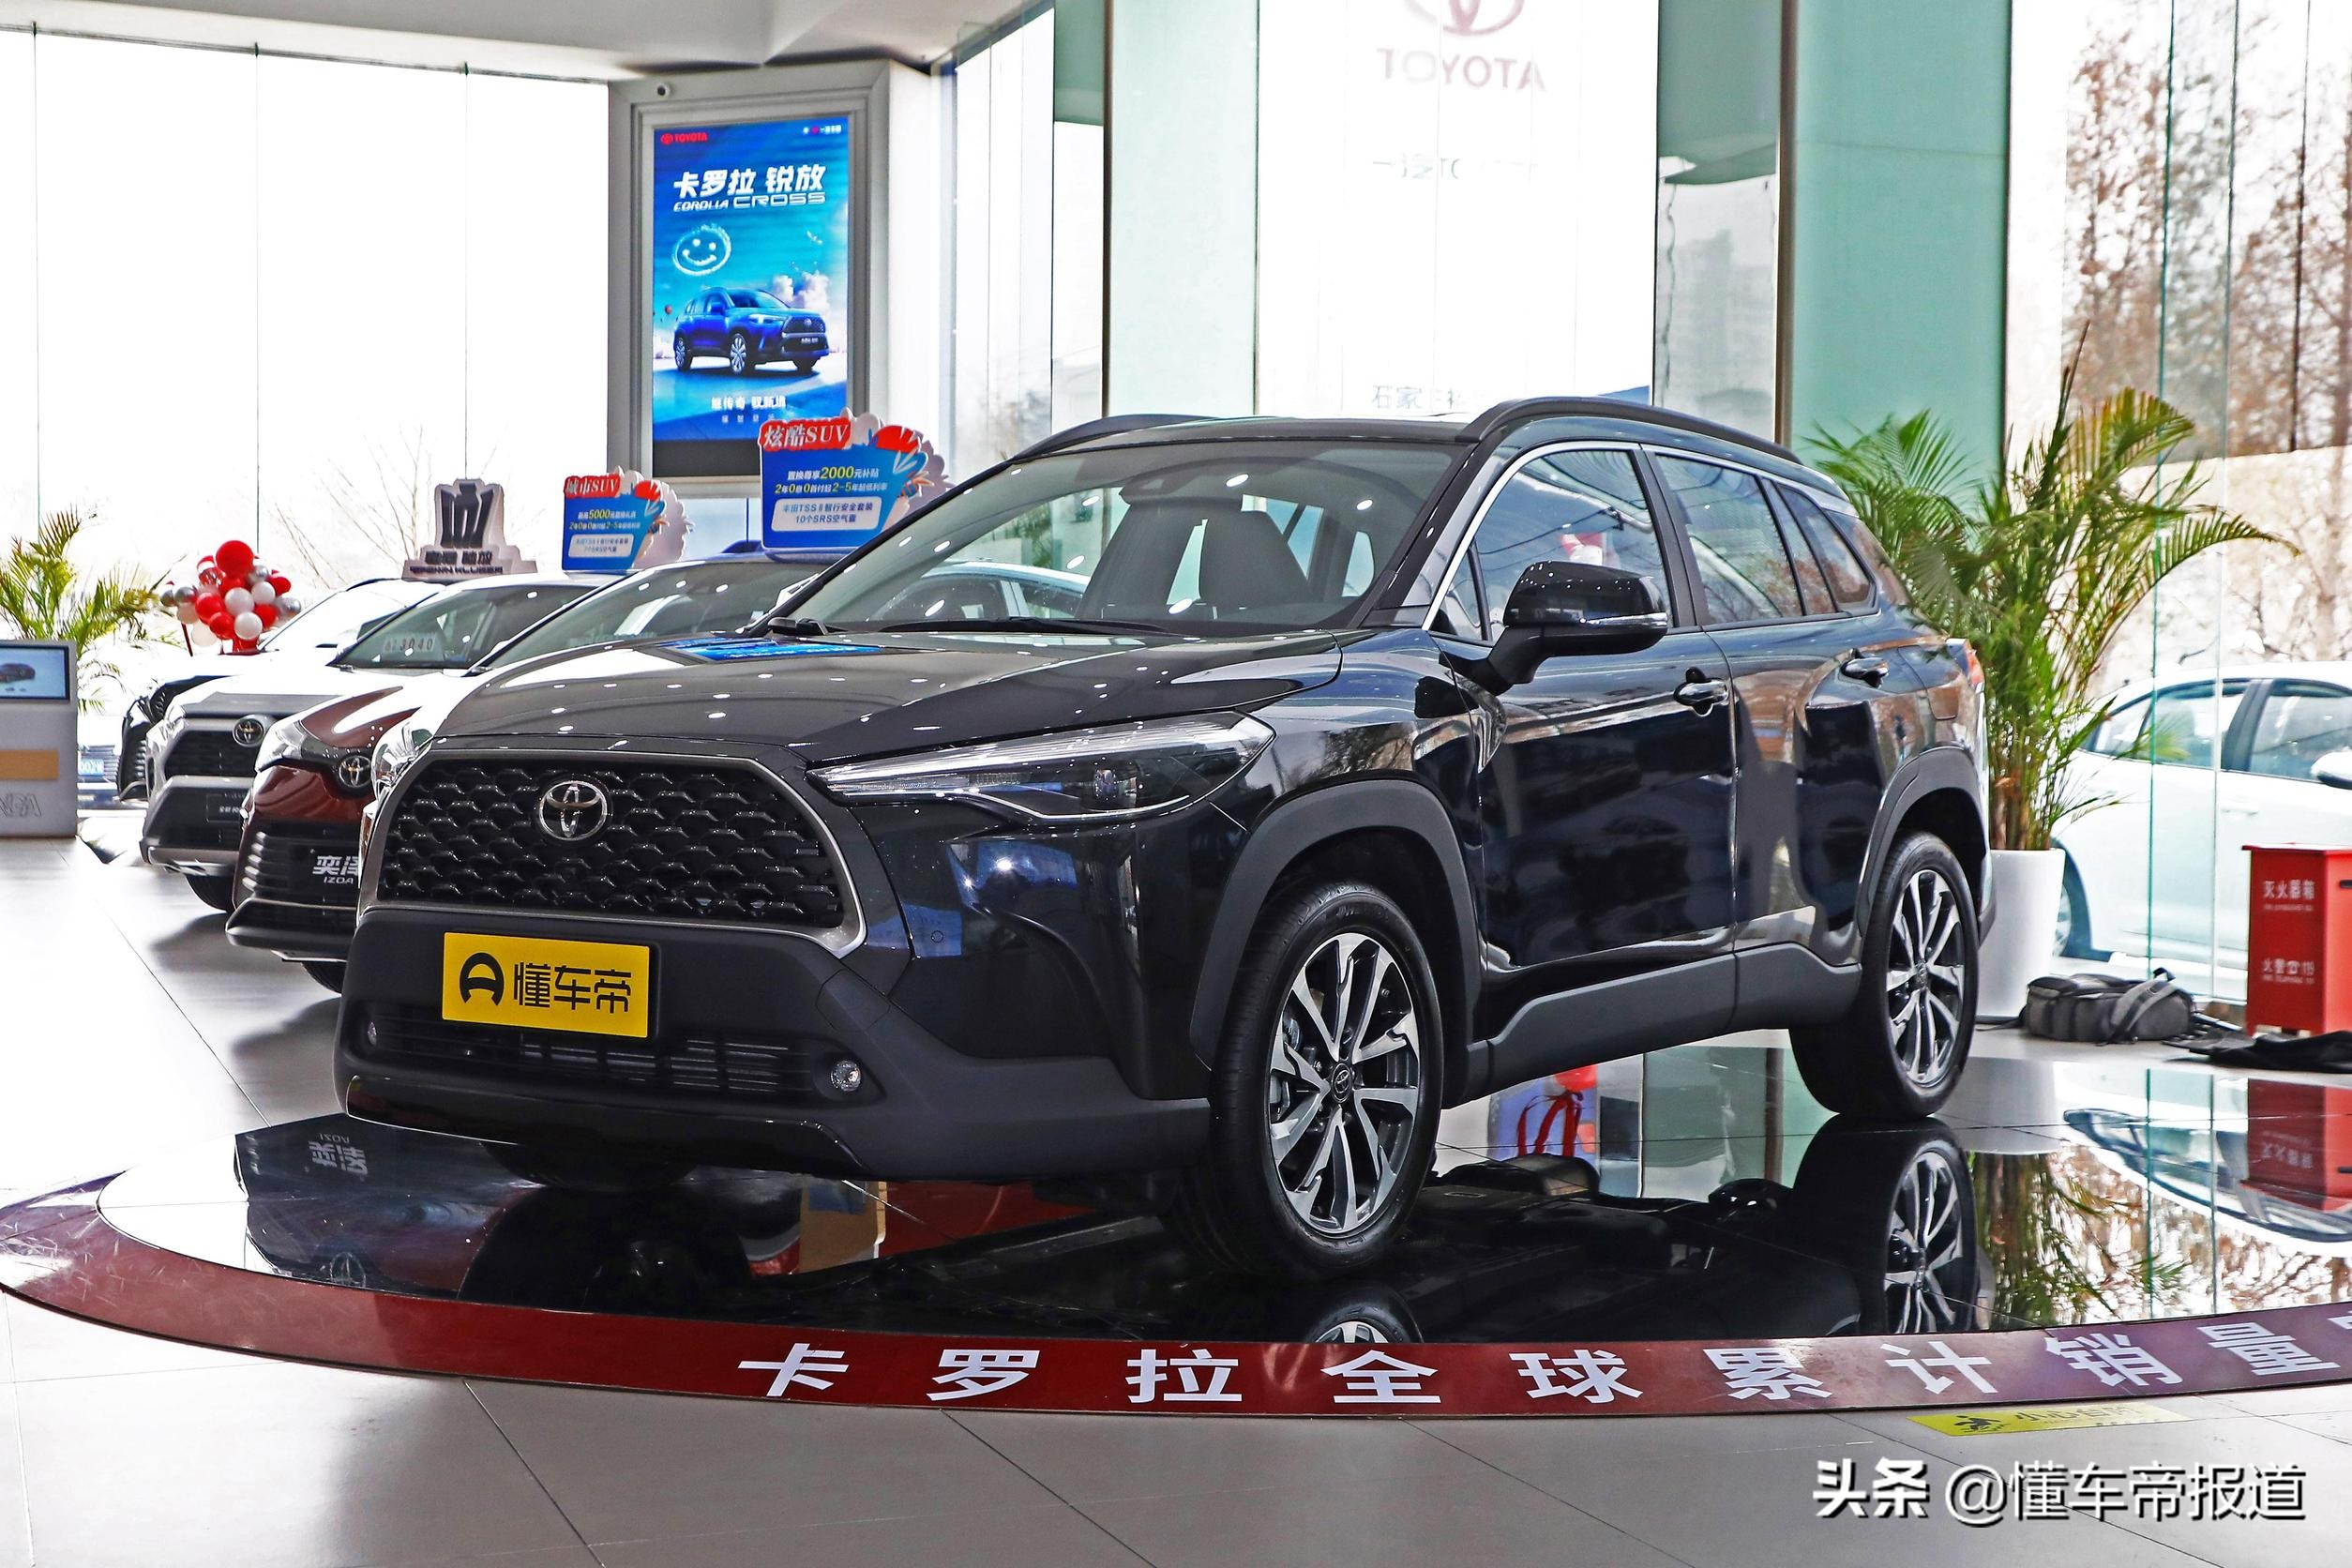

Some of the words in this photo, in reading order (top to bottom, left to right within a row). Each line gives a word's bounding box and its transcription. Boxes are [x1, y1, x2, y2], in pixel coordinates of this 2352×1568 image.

[1376, 47, 1547, 93] TOYOTA
[674, 132, 708, 143] TOYOTA
[673, 168, 757, 198] 卡罗拉
[765, 163, 827, 193] 锐放
[733, 191, 826, 208] CROSS
[763, 423, 849, 448] 炫酷SUV
[324, 876, 354, 884] IZOA
[2263, 880, 2315, 899] 灭火器箱
[514, 962, 631, 1013] 懂车帝
[738, 1310, 2352, 1403] 卡罗拉全球累计销量
